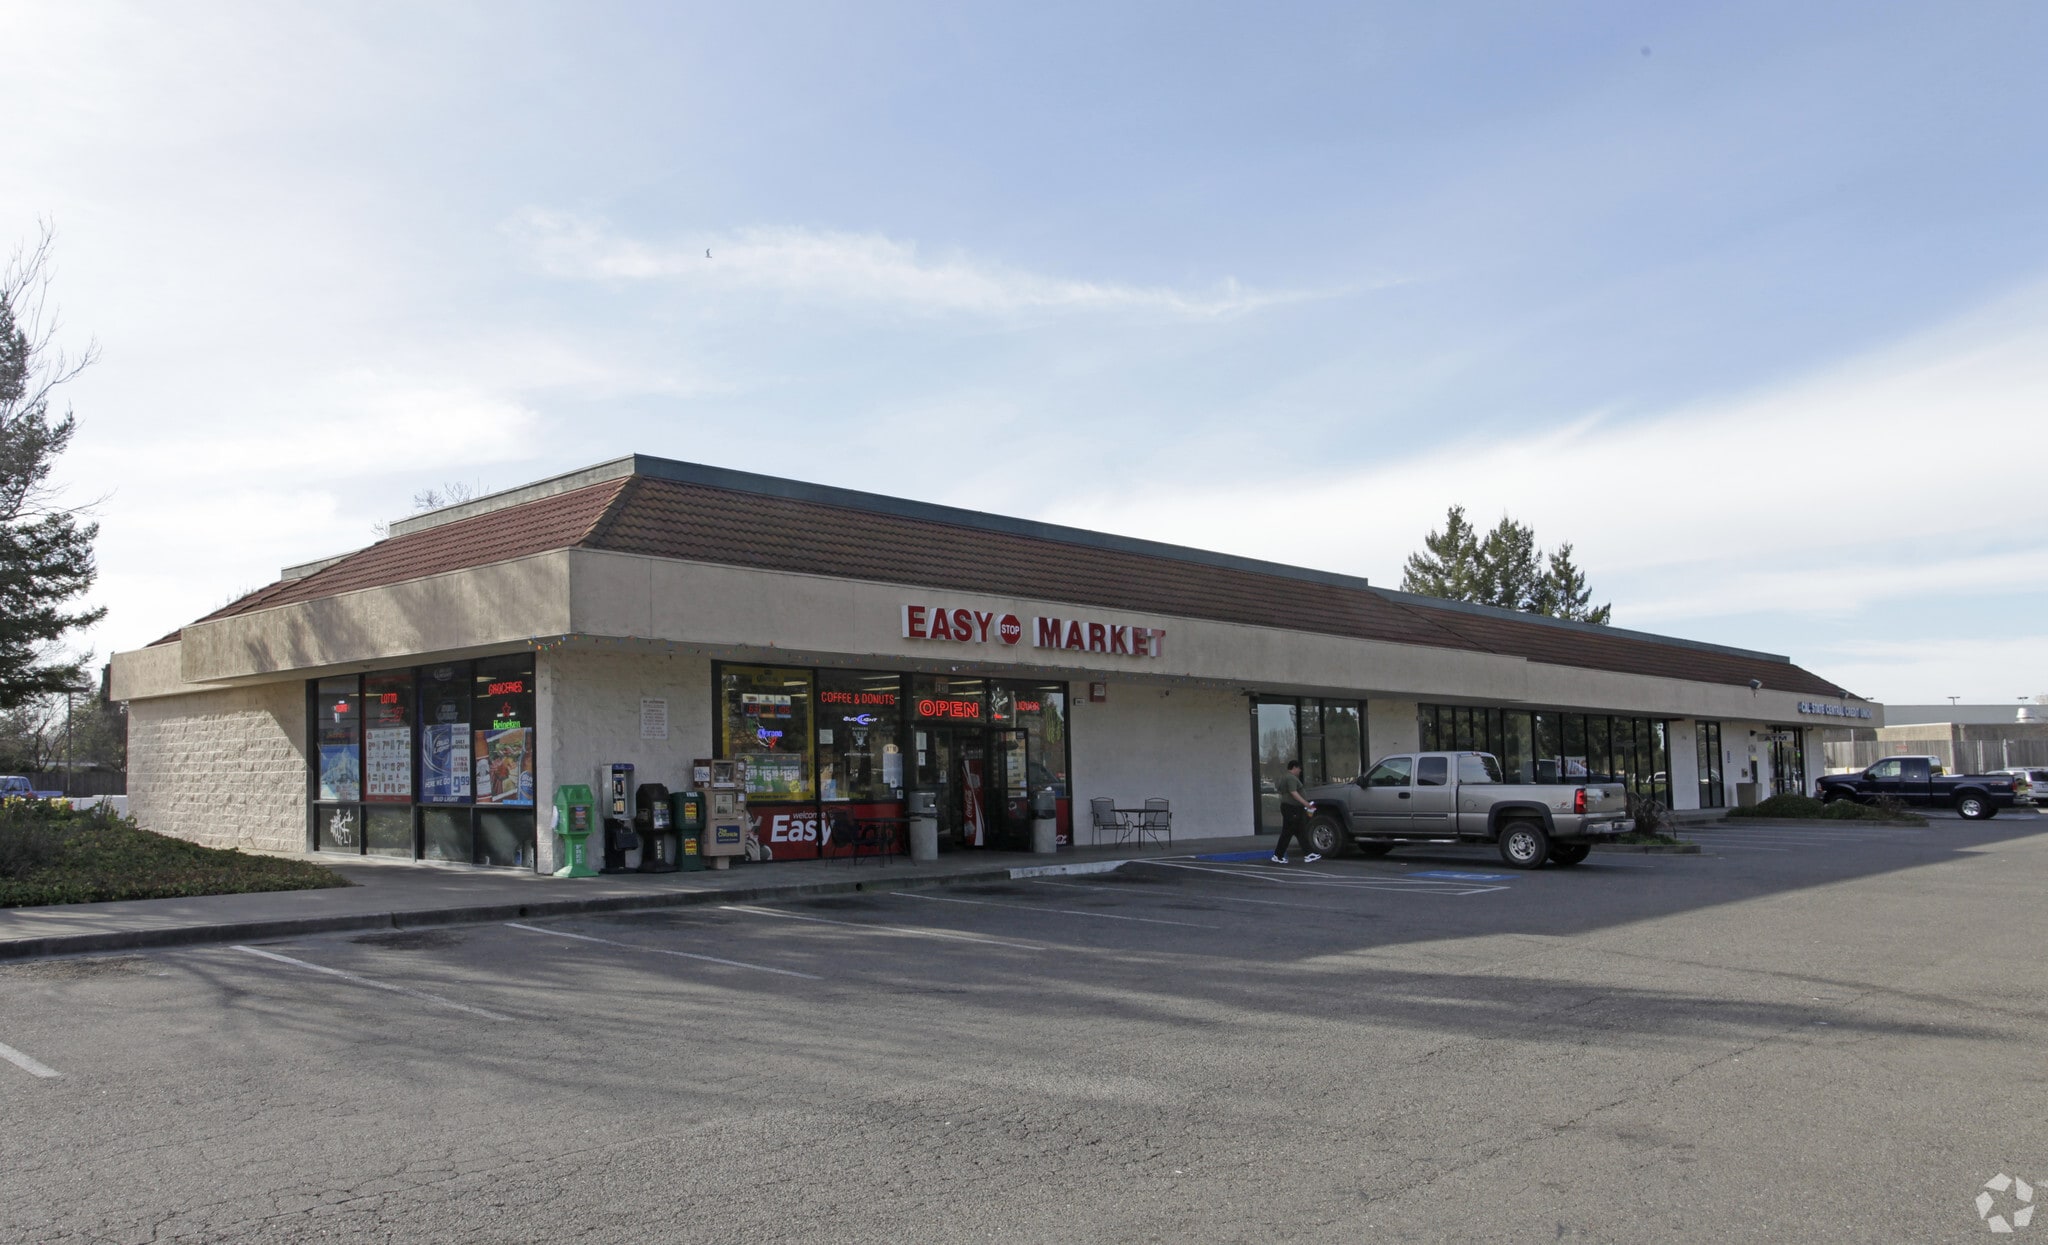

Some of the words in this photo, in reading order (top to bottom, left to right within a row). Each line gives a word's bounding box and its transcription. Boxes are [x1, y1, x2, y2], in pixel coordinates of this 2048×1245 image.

[902, 605, 993, 643] EASY
[1001, 624, 1020, 635] STOP
[1033, 616, 1166, 657] MARKET
[488, 681, 523, 696] GROCERIES
[381, 692, 397, 704] LOTTO
[821, 691, 852, 704] COFFEE
[854, 693, 860, 704] &
[861, 693, 895, 705] DONUTS
[919, 700, 979, 718] OPEN
[1015, 701, 1039, 711] LIQUOR
[493, 719, 521, 730] Heineken
[757, 728, 783, 739] Corona
[770, 815, 836, 847] Easy
